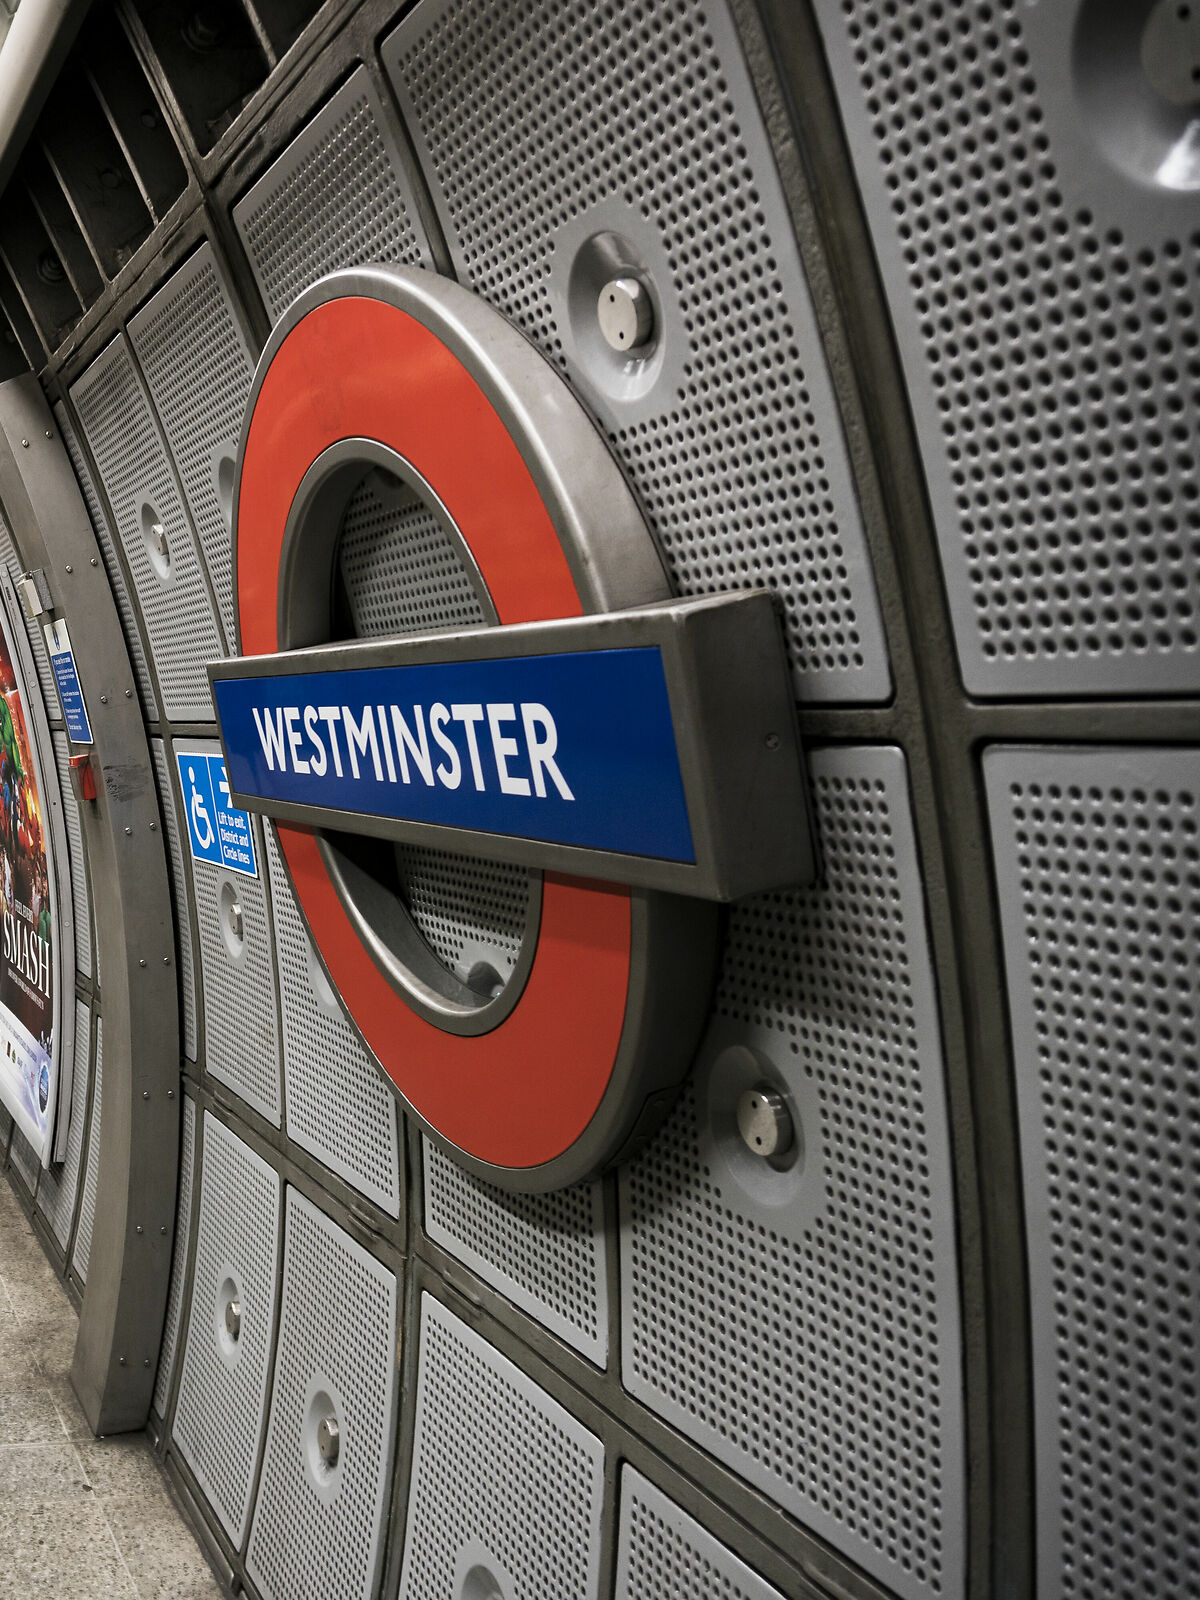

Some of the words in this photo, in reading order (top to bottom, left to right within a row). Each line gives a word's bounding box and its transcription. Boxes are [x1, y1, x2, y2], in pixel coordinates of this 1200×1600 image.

[252, 702, 575, 801] WESTMINSTER
[218, 811, 228, 826] Lift
[220, 828, 239, 844] District
[238, 834, 250, 848] and
[223, 845, 238, 861] Circle
[238, 849, 251, 865] lines
[3, 909, 50, 999] SMASH
